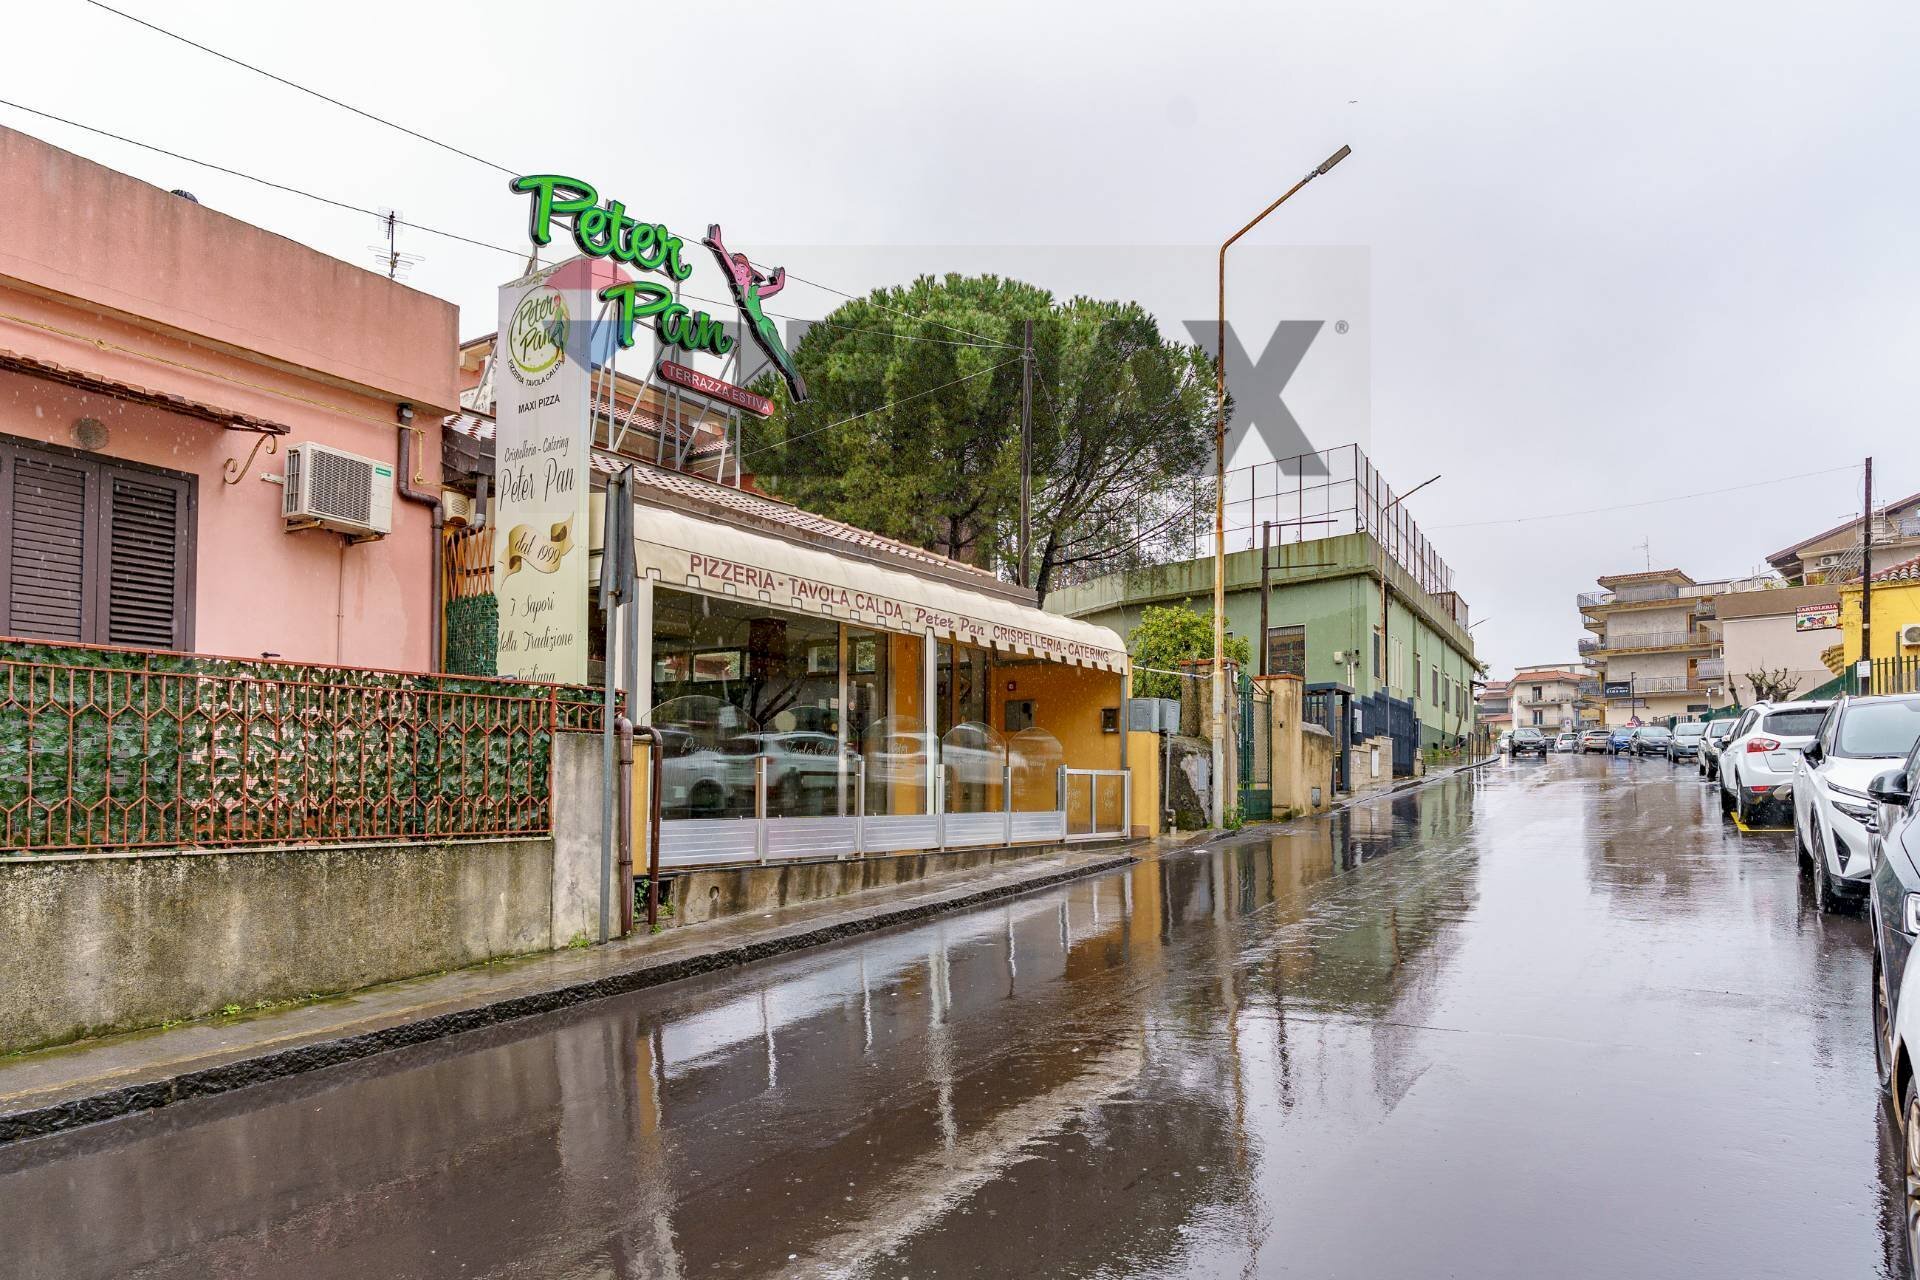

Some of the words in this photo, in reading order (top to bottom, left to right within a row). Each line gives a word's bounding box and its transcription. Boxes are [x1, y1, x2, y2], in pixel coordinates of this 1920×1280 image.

[509, 174, 692, 282] Peter
[518, 295, 556, 336] Peter
[597, 281, 734, 355] Pan
[520, 326, 551, 362] Pan
[526, 377, 546, 387] TAVOLA
[667, 365, 730, 398] TERRAZZA
[732, 388, 770, 413] ESTIVA
[518, 400, 536, 414] MAXI
[538, 394, 561, 408] PIZZA
[543, 436, 569, 457] Catering
[499, 465, 535, 511] Peter
[543, 457, 576, 502] Pan
[515, 532, 536, 554] dal
[537, 544, 561, 565] 1999
[521, 592, 555, 623] Sapori
[690, 554, 776, 590] PIZZERIA
[788, 577, 850, 606] TAVOLA
[855, 593, 903, 619] CALDA
[915, 607, 954, 629] Peter
[959, 617, 985, 637] Pan
[993, 625, 1063, 653] CRISPELLERIA
[1068, 642, 1110, 663] CATERING
[523, 625, 574, 652] Tradizione
